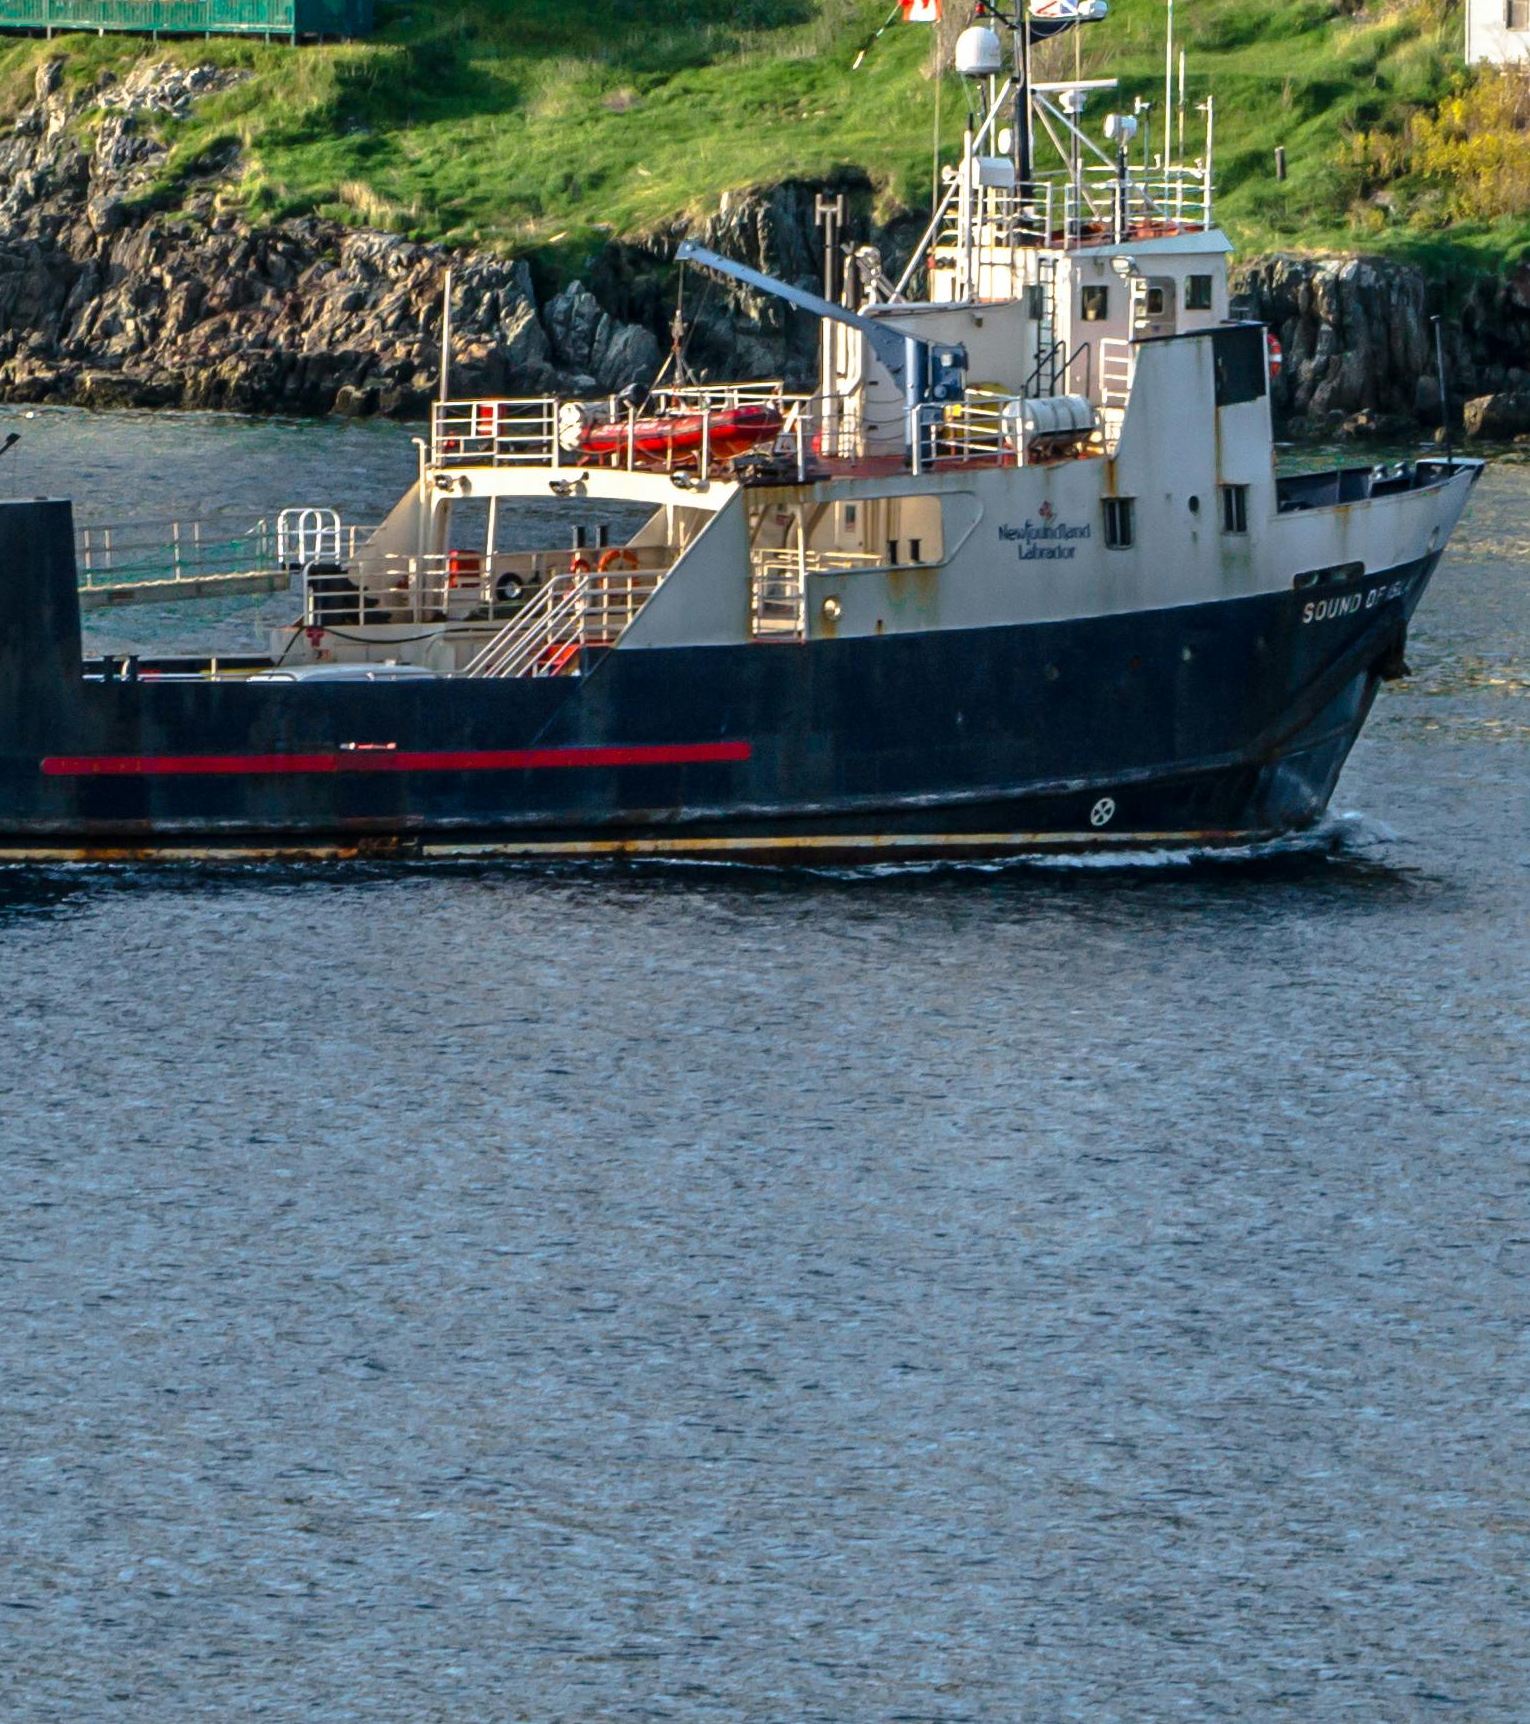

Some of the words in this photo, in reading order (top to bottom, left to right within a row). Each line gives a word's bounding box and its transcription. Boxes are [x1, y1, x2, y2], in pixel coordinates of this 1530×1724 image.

[1018, 542, 1076, 560] Labrador
[1301, 593, 1363, 624] SOUND
[1365, 585, 1388, 609] OF
